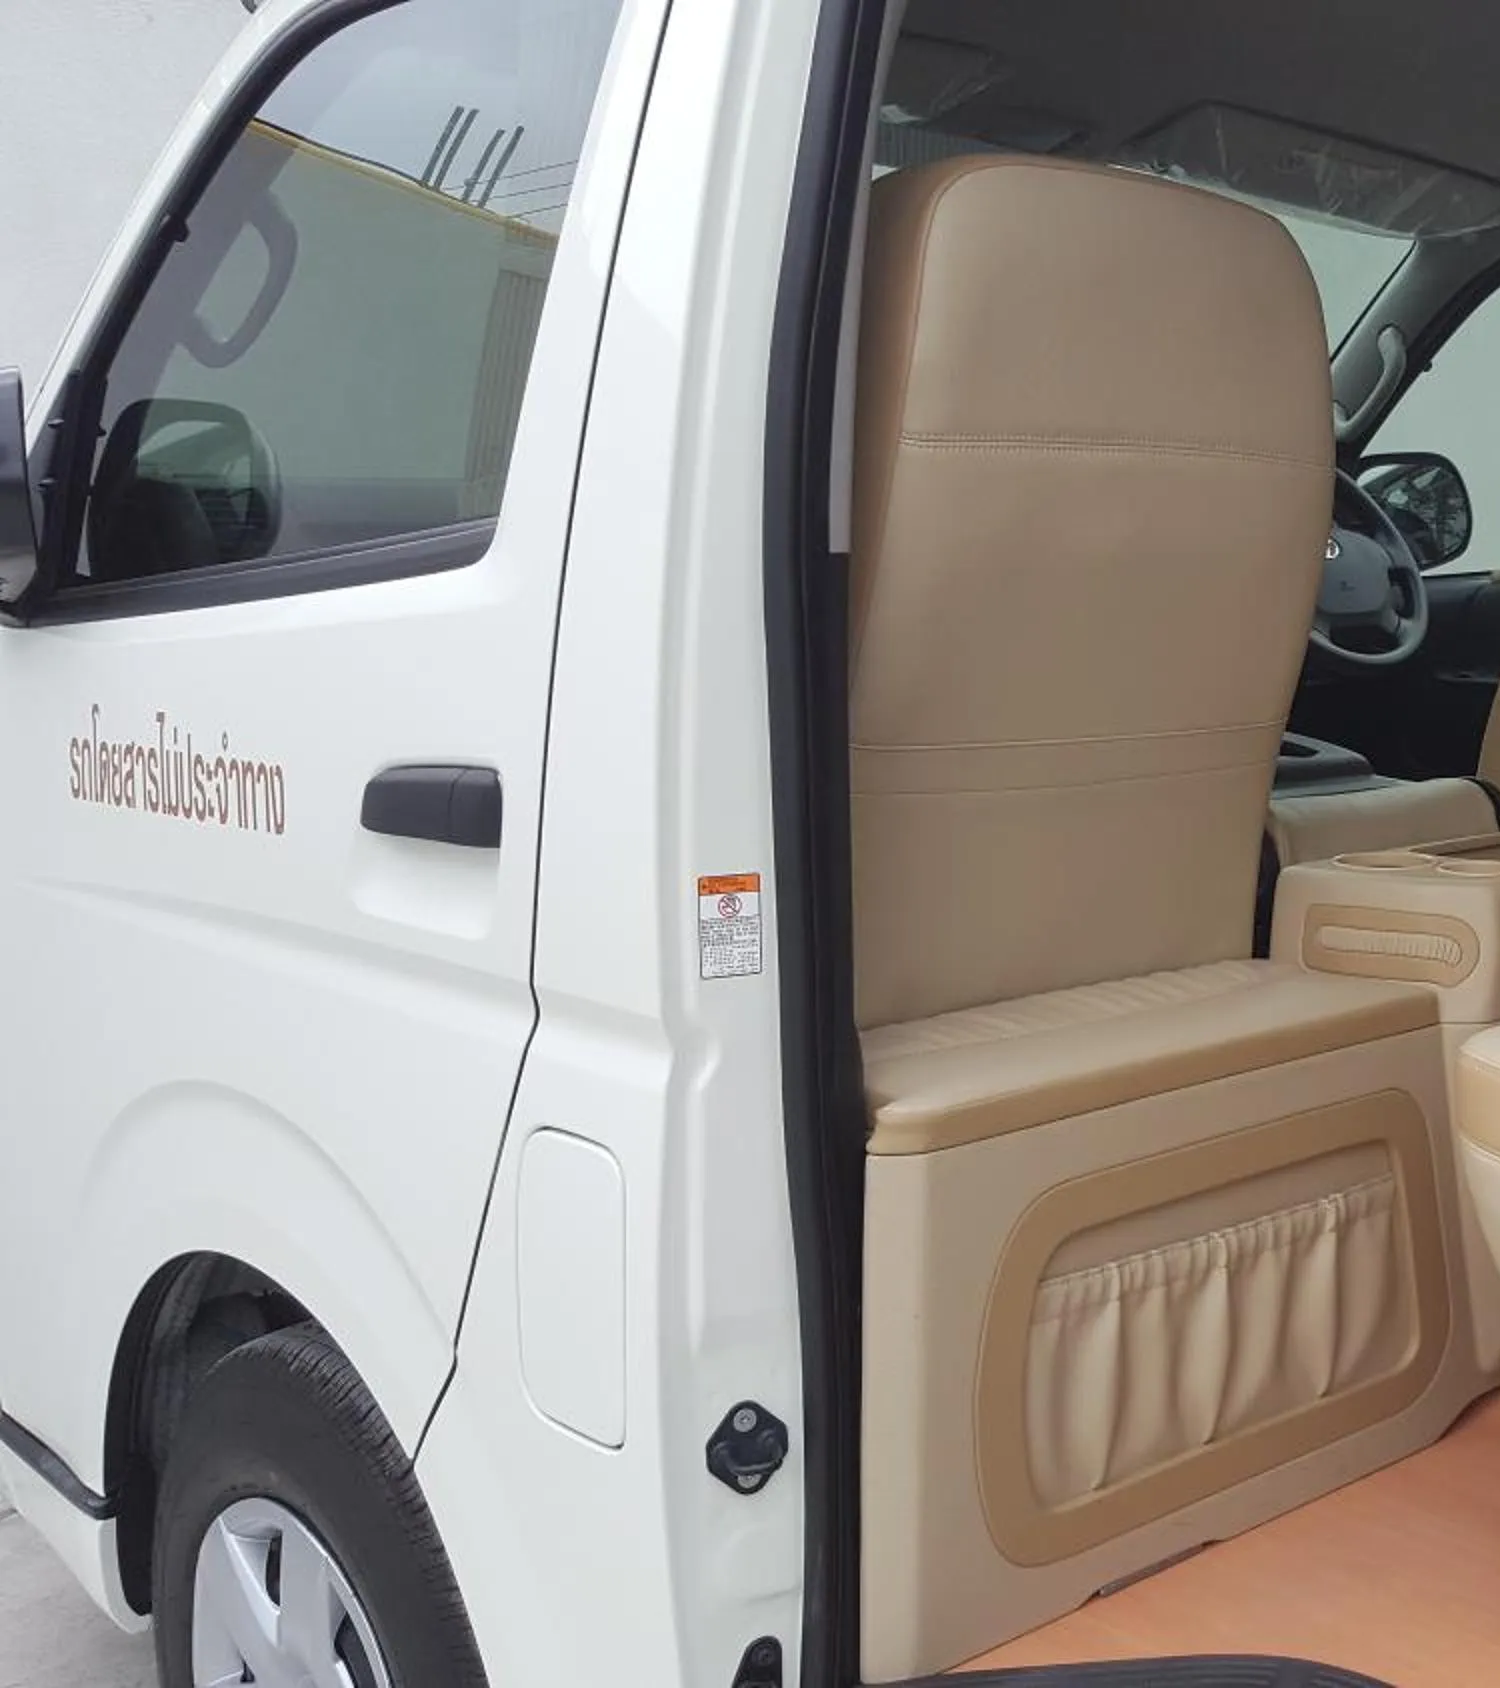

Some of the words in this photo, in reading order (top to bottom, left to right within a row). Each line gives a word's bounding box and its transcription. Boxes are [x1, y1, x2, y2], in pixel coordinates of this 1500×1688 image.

[69, 703, 285, 835] รถโดยสารไม่ประจำทาง
